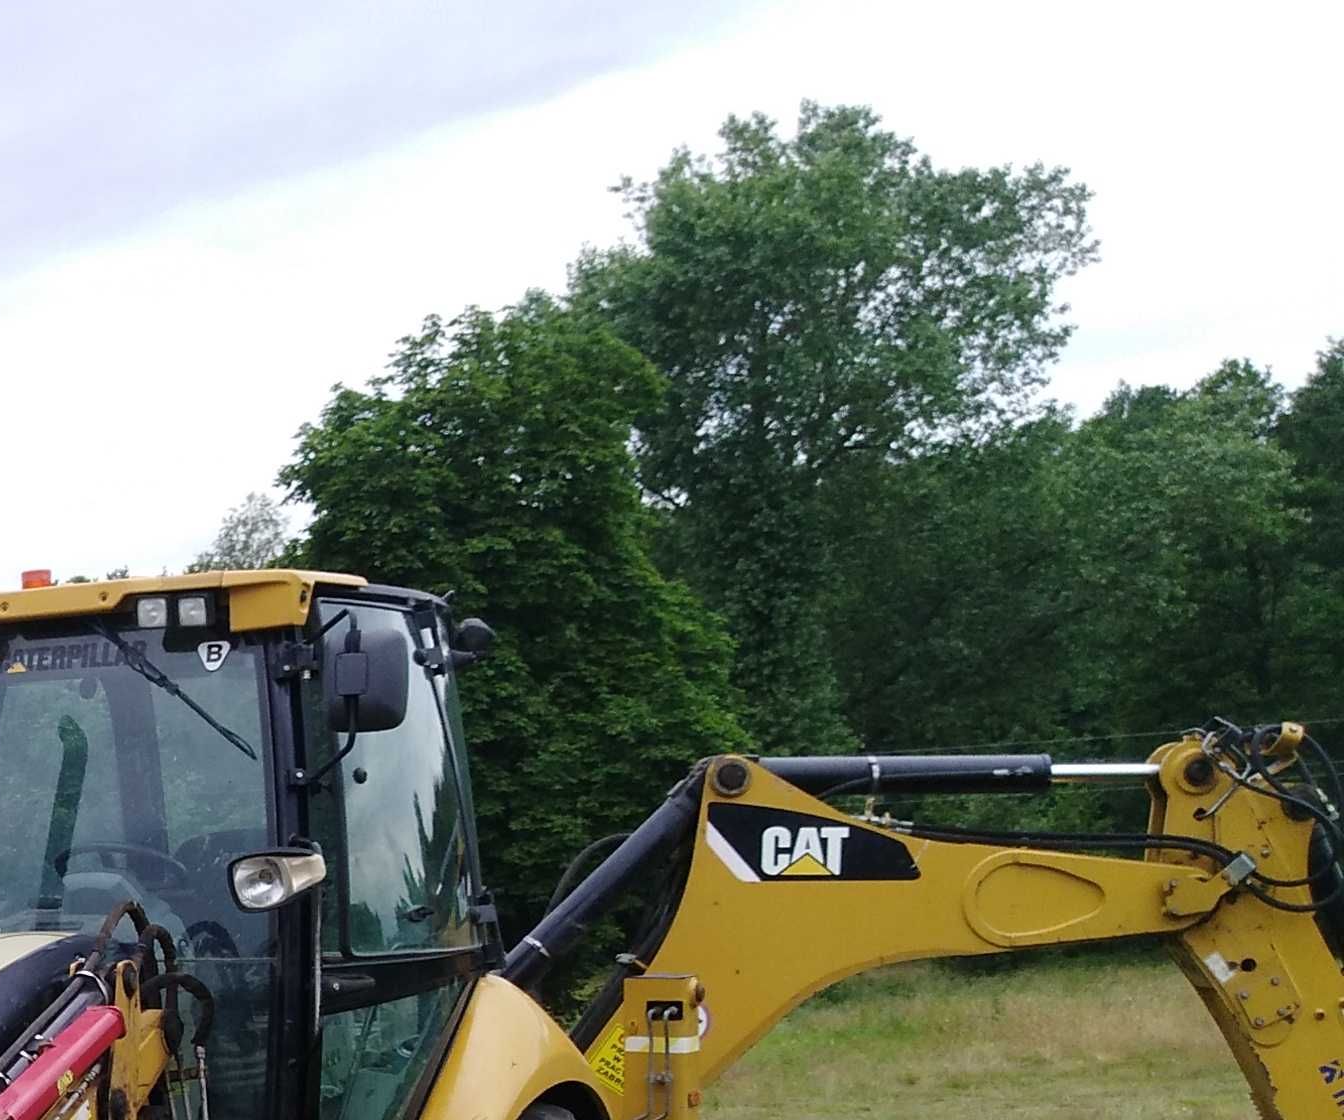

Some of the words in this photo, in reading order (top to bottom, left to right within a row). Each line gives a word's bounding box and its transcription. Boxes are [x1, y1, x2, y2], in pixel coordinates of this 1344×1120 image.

[1, 640, 148, 673] ATERPILLR
[205, 644, 223, 664] B
[761, 825, 851, 876] CAT
